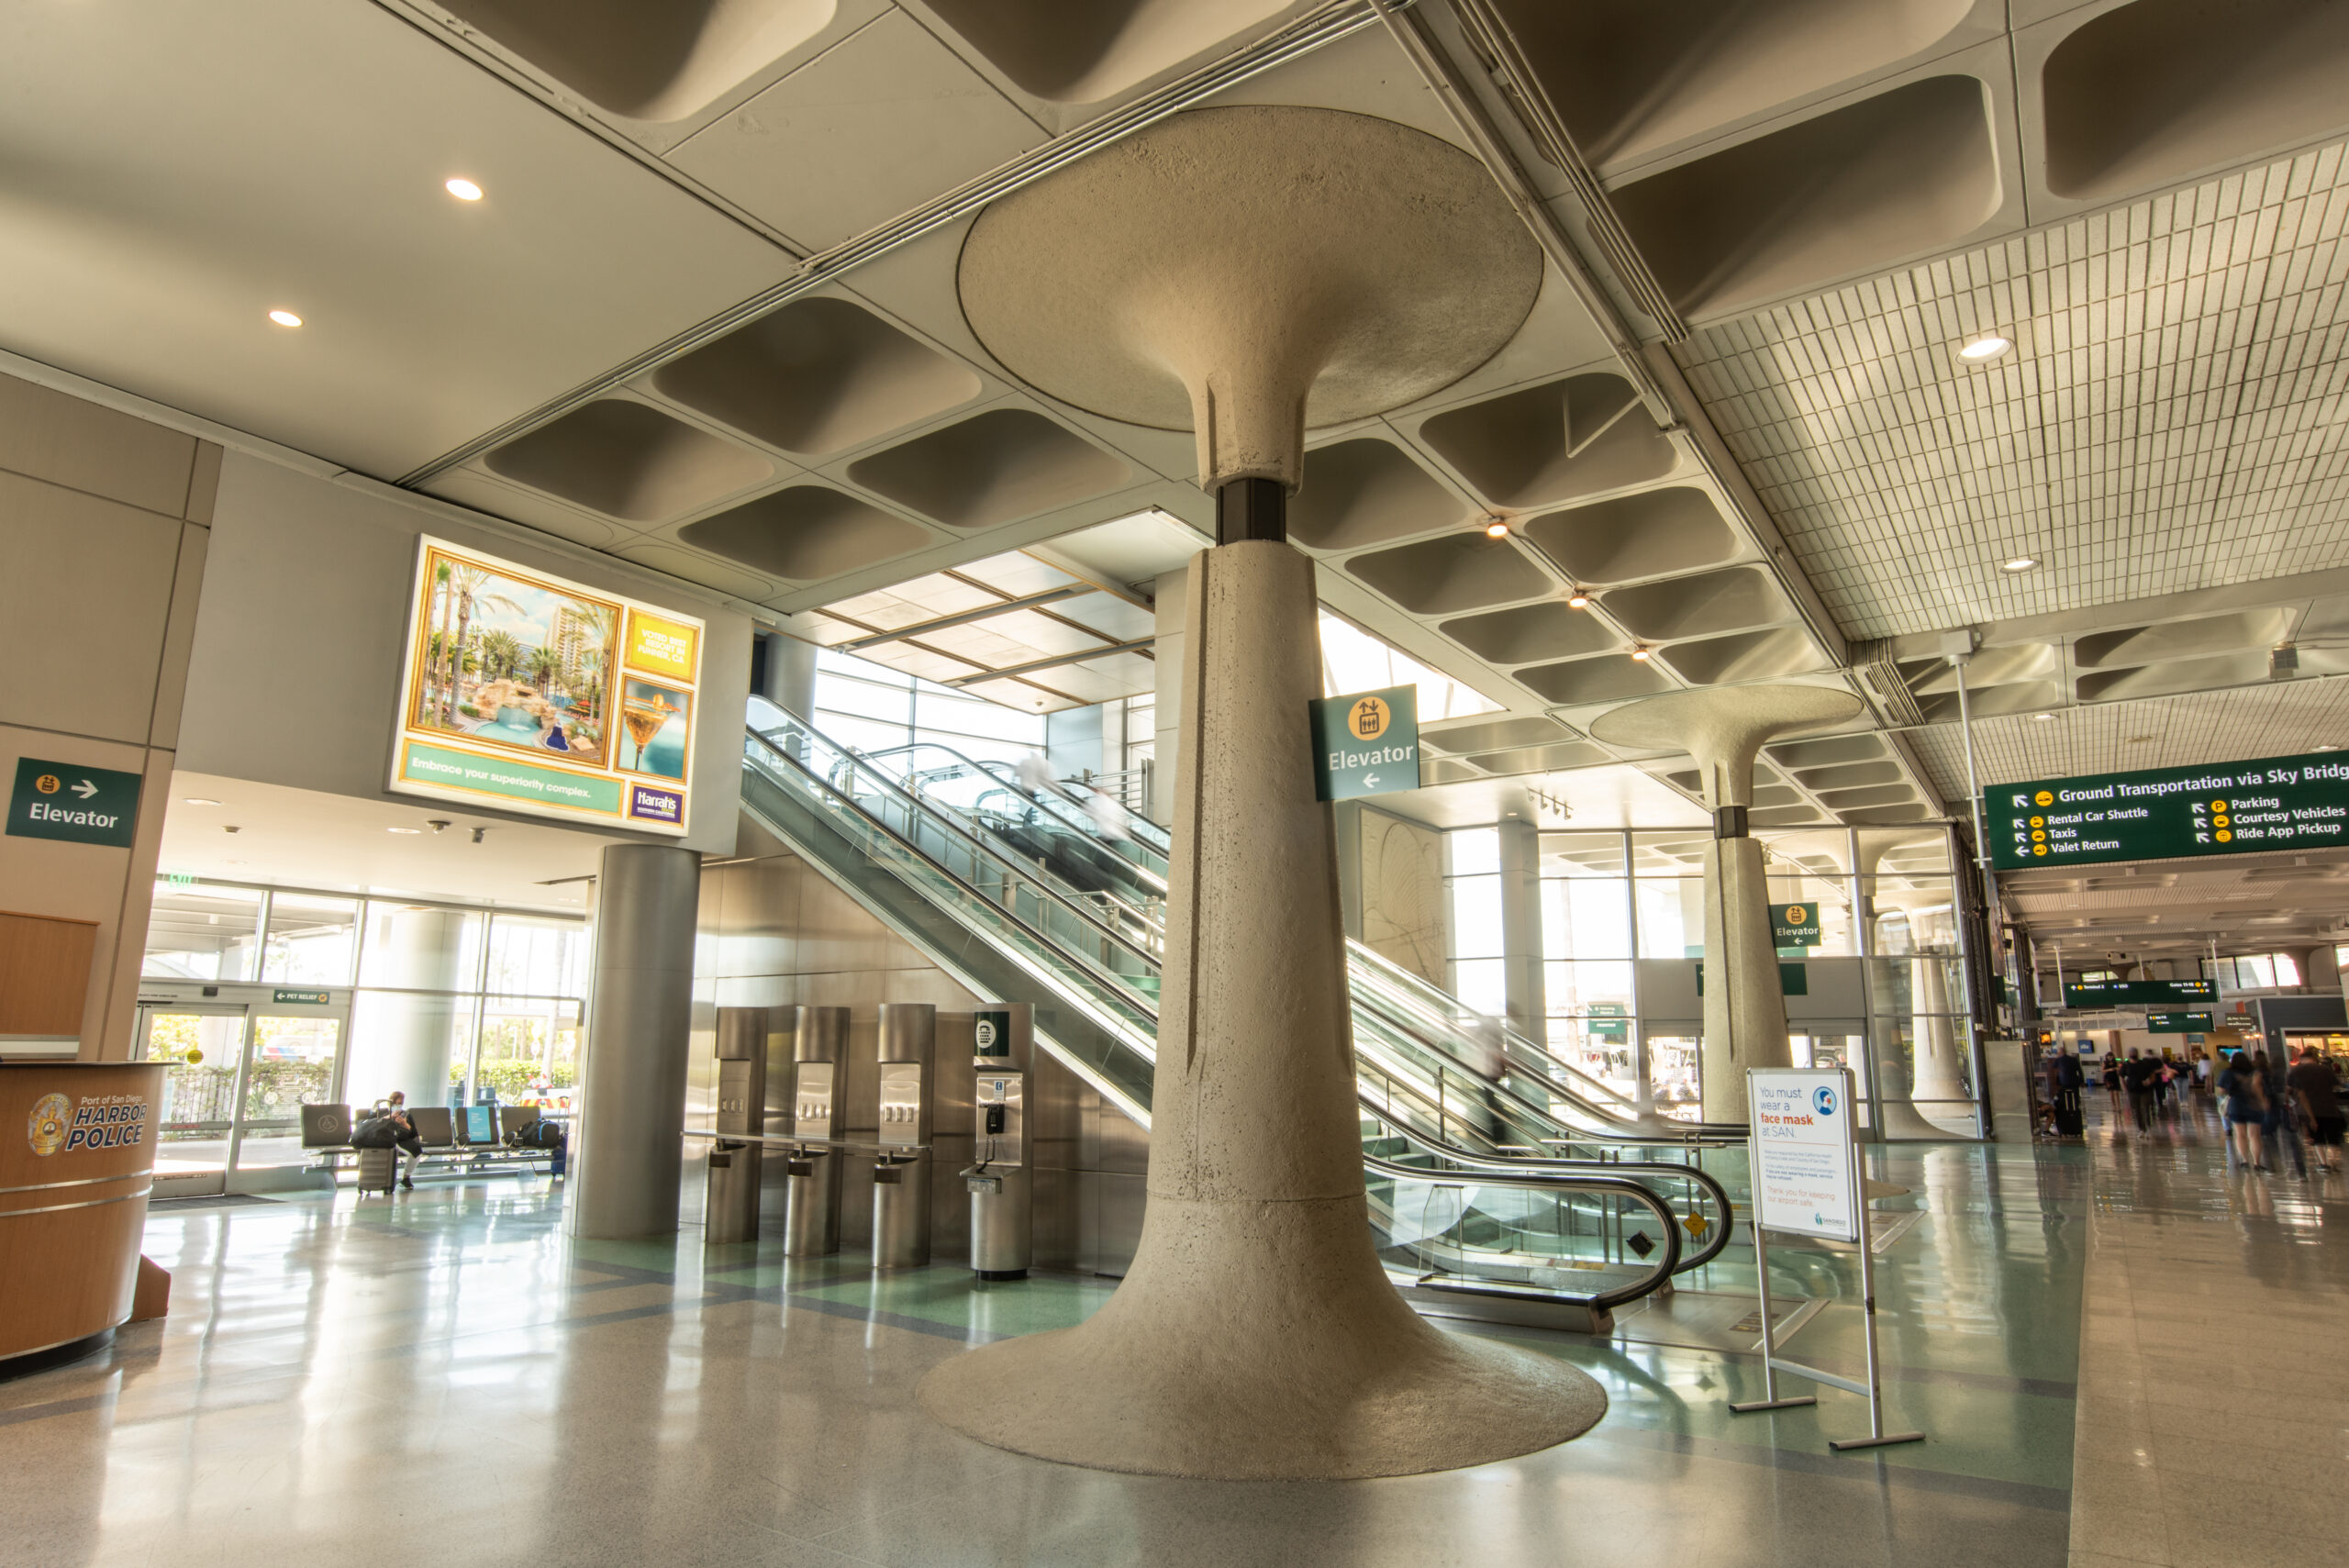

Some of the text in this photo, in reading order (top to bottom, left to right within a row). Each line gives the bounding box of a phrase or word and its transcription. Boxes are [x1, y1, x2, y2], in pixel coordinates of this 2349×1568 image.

[641, 628, 668, 642] VOTED
[645, 639, 675, 652] RESORT
[672, 654, 685, 664] CA
[1329, 745, 1414, 771] Elevator
[412, 757, 591, 799] Embrace your superiority complex.
[2059, 784, 2114, 803] Ground
[2117, 775, 2233, 798] Transportation
[2236, 772, 2263, 786] via
[2266, 768, 2298, 784] Sky
[638, 791, 676, 809] Harrah's
[2231, 796, 2280, 809] Parking
[29, 802, 118, 828] Elevator
[2047, 807, 2148, 825] Rental Car Shuttle
[2233, 806, 2346, 824] Courtesy Vehicles
[2048, 828, 2077, 839] Taxis
[2235, 822, 2341, 840] Ride App Pickup
[2051, 840, 2120, 853] Valet Return
[169, 873, 193, 888] EXIT
[1776, 927, 1819, 937] Elevator
[1760, 1086, 1802, 1098] You must
[81, 1095, 142, 1106] Port of San Diego
[1760, 1101, 1790, 1111] wear a
[73, 1104, 148, 1127] HARBOR
[1761, 1112, 1814, 1126] face mask
[65, 1123, 144, 1151] POLICE
[1762, 1126, 1798, 1138] at SAN.
